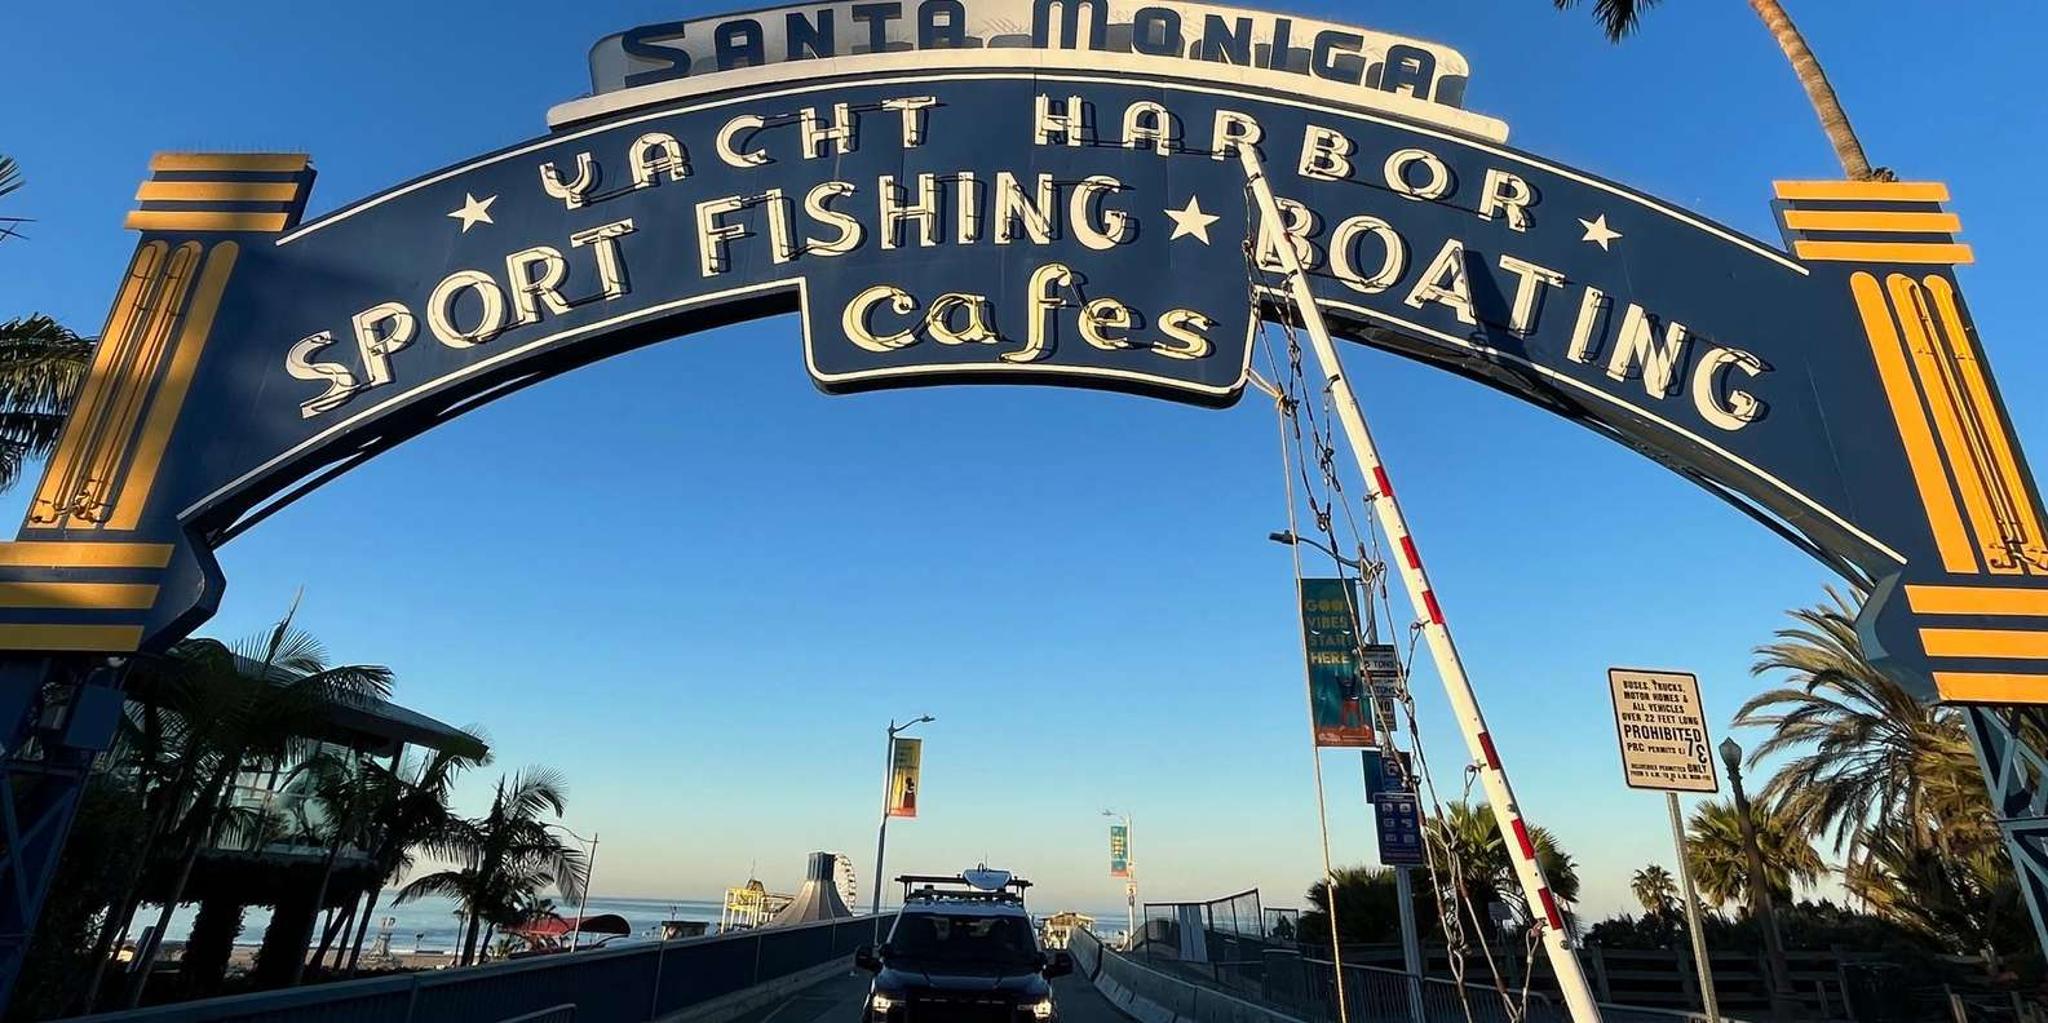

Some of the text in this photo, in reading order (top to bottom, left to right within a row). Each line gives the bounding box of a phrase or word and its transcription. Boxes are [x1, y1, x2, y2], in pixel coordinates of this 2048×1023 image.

[622, 0, 1436, 101] SANTA MONICA
[539, 93, 1531, 232] YACHT HARBOR
[285, 171, 1764, 430] SPORT FISHING BOATING
[841, 263, 1217, 364] cafes
[1306, 616, 1348, 629] VIBES
[1310, 652, 1351, 664] HERE
[1623, 691, 1651, 701] MOTOR
[1652, 693, 1680, 703] HOMES
[1632, 702, 1685, 714] ALL VEHICLES
[1621, 712, 1699, 725] OVER 22 FEET LONG
[1623, 724, 1702, 742] PROHIBITED
[1627, 742, 1645, 752] PRC
[1687, 763, 1707, 774] ONLY
